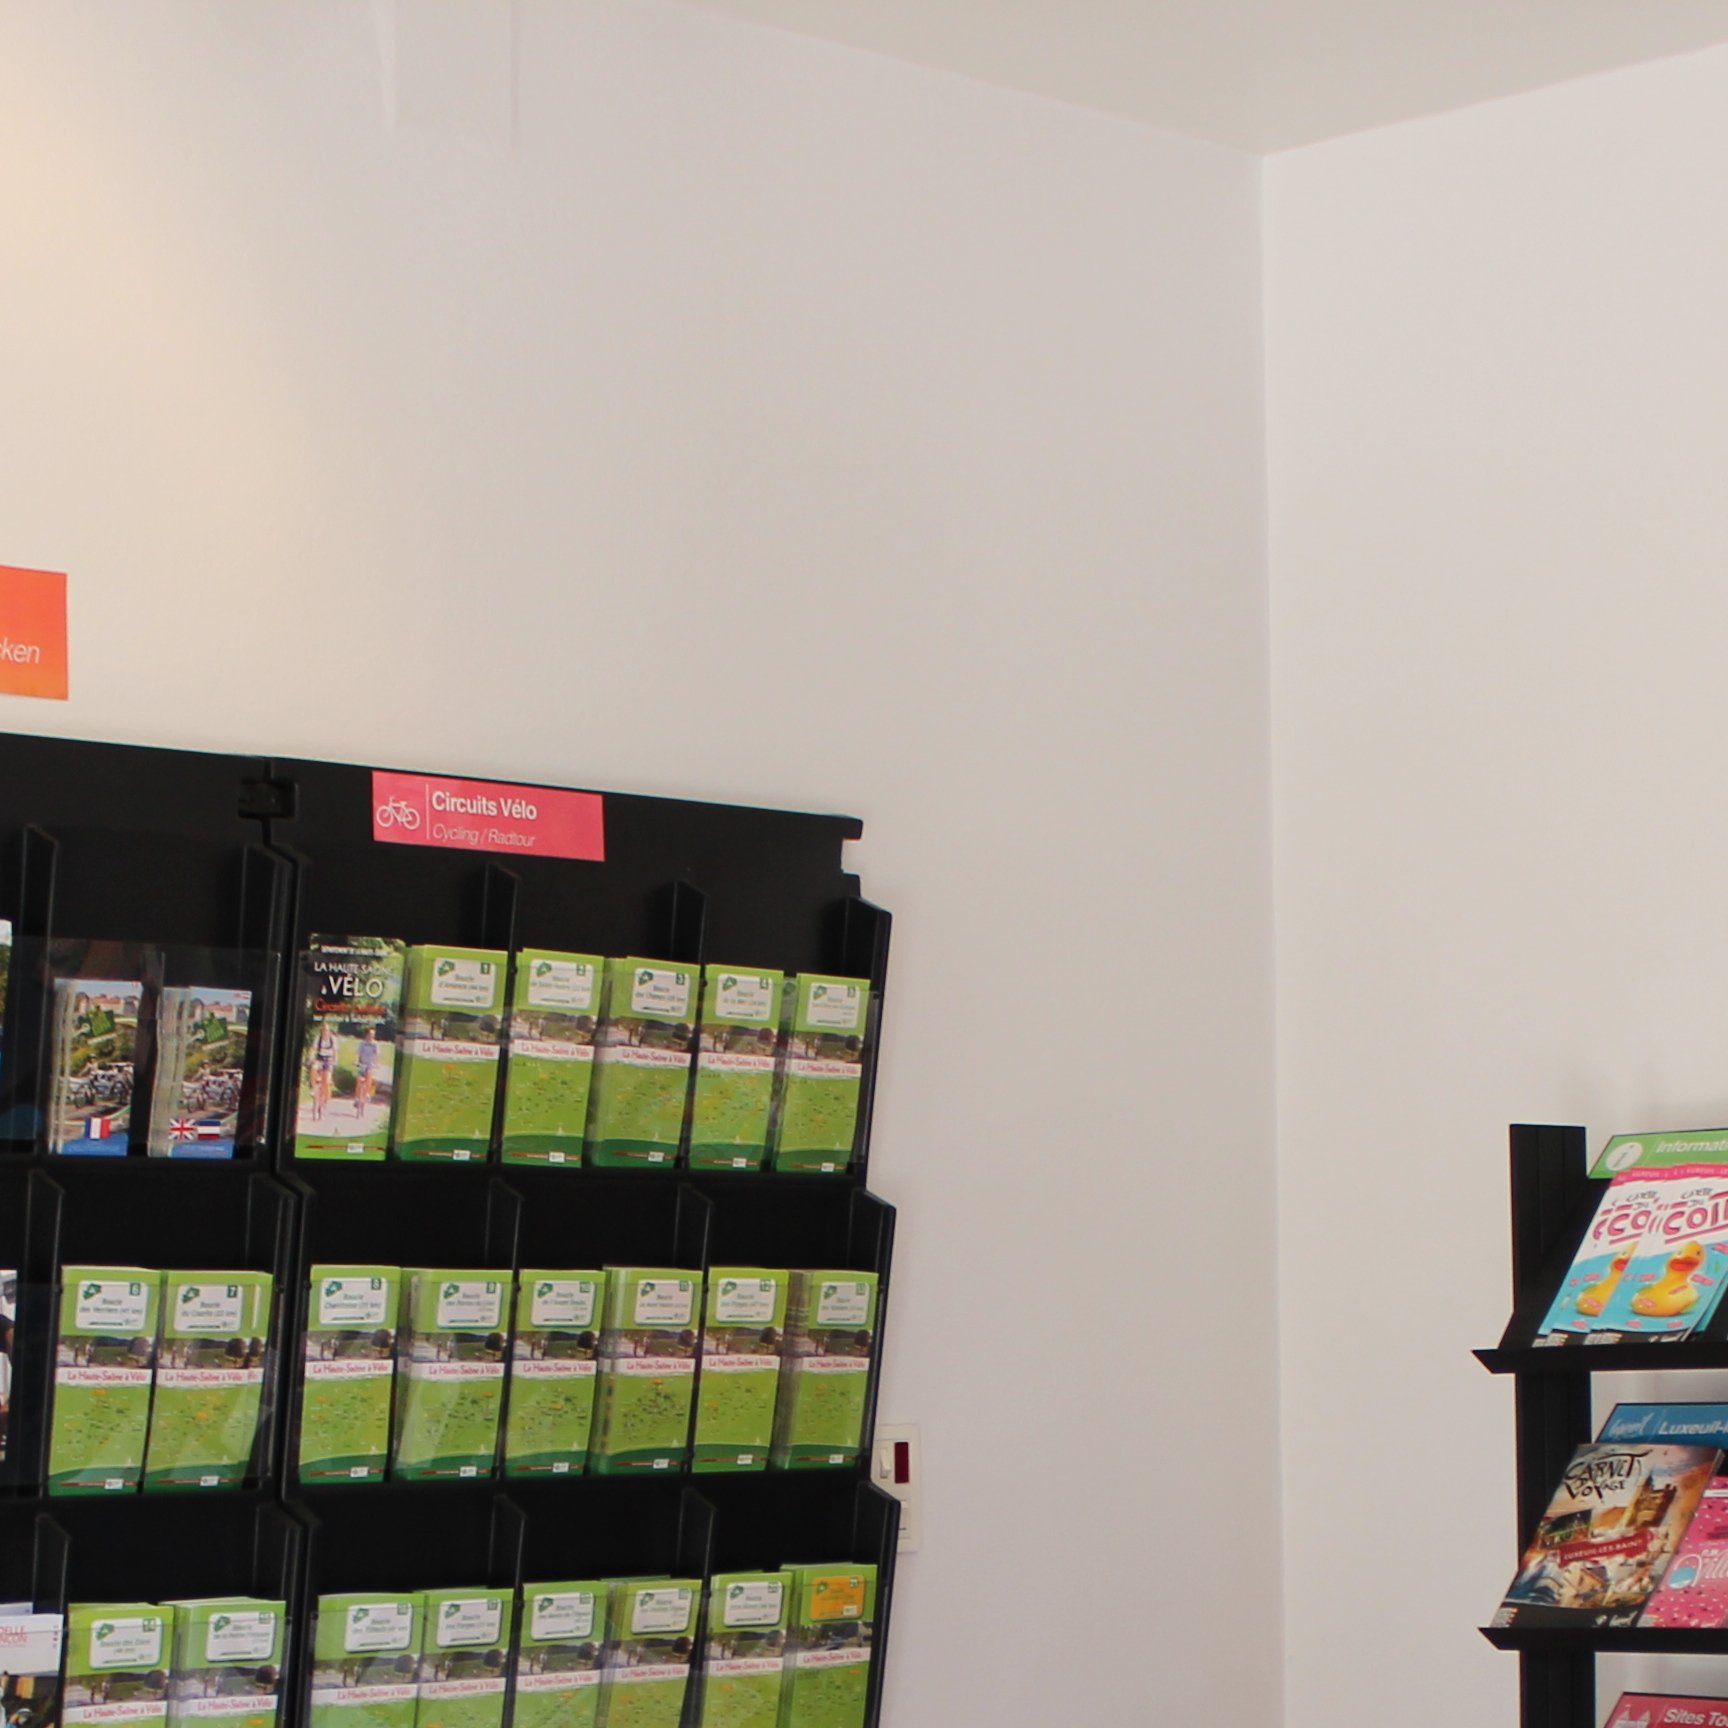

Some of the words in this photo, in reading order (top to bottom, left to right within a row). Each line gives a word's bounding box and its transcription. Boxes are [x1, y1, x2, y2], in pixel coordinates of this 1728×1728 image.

[431, 790, 498, 816] Circuits
[501, 795, 537, 820] Vélo
[432, 824, 477, 847] Cycling
[488, 828, 535, 848] Radtour
[328, 973, 384, 998] VÉLO
[1664, 1708, 1704, 1725] Sites
